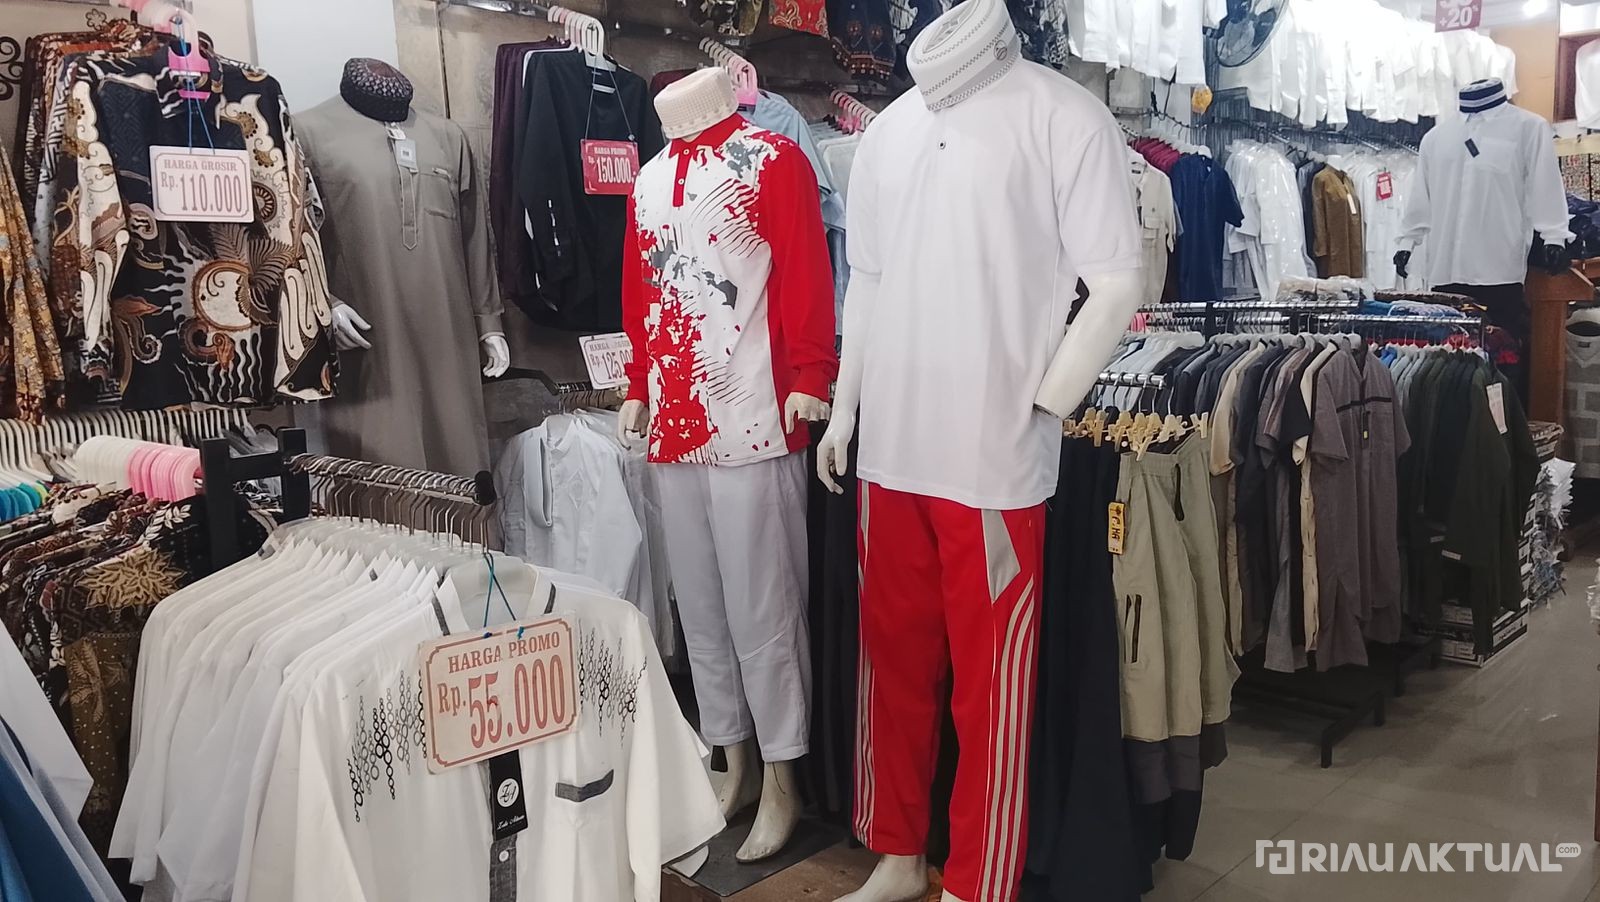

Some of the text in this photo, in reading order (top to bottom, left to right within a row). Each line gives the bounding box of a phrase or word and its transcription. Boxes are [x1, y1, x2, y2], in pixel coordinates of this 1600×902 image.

[164, 159, 237, 171] HARGA GROSIR
[448, 631, 560, 674] HARGA PROMO
